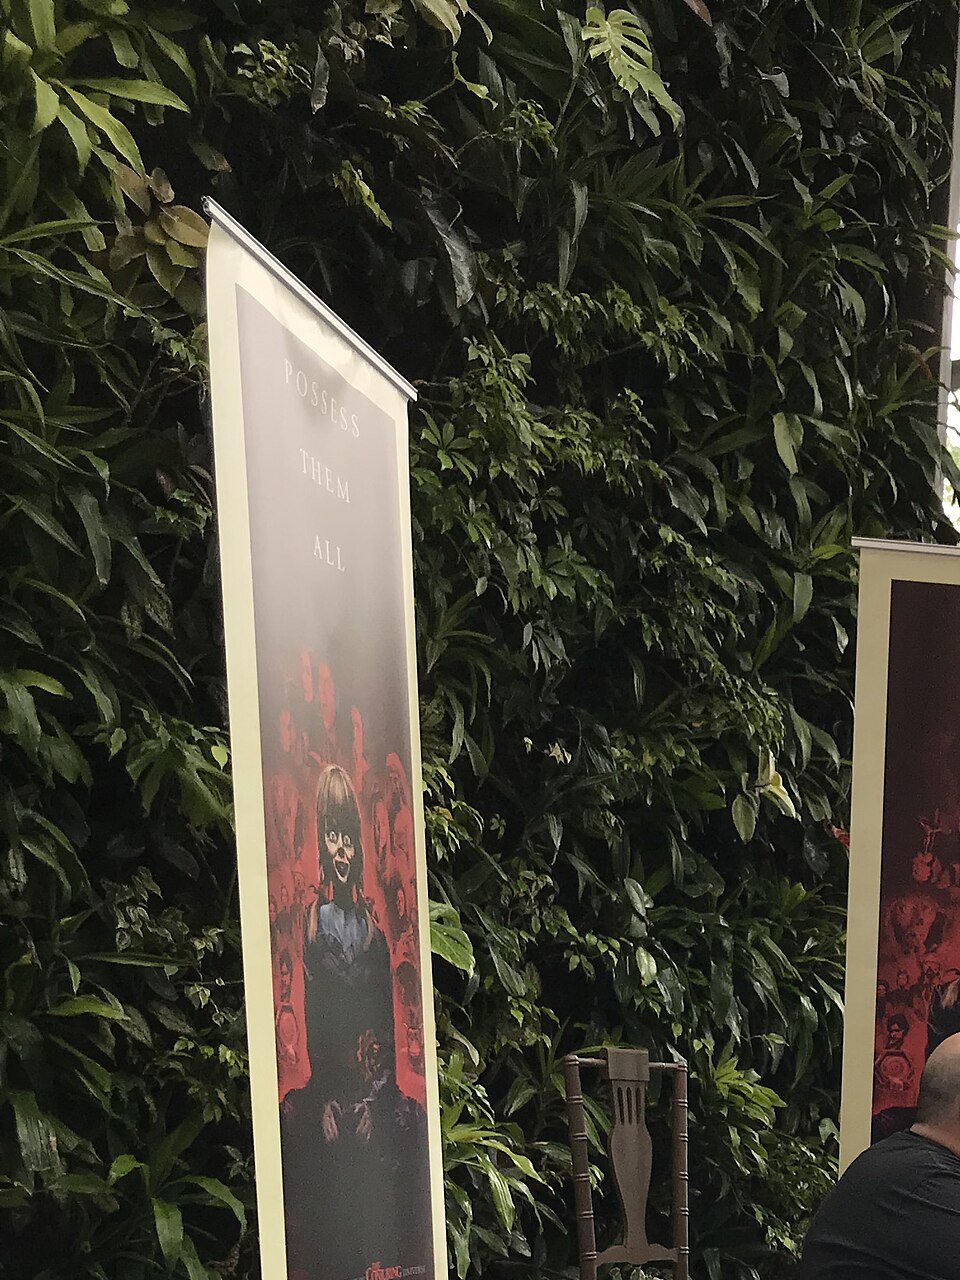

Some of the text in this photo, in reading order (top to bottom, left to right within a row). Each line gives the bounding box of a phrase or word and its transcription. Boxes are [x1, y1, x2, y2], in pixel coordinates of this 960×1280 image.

[285, 359, 360, 438] POSSESS
[300, 448, 351, 503] THEM
[313, 535, 346, 572] ALL
